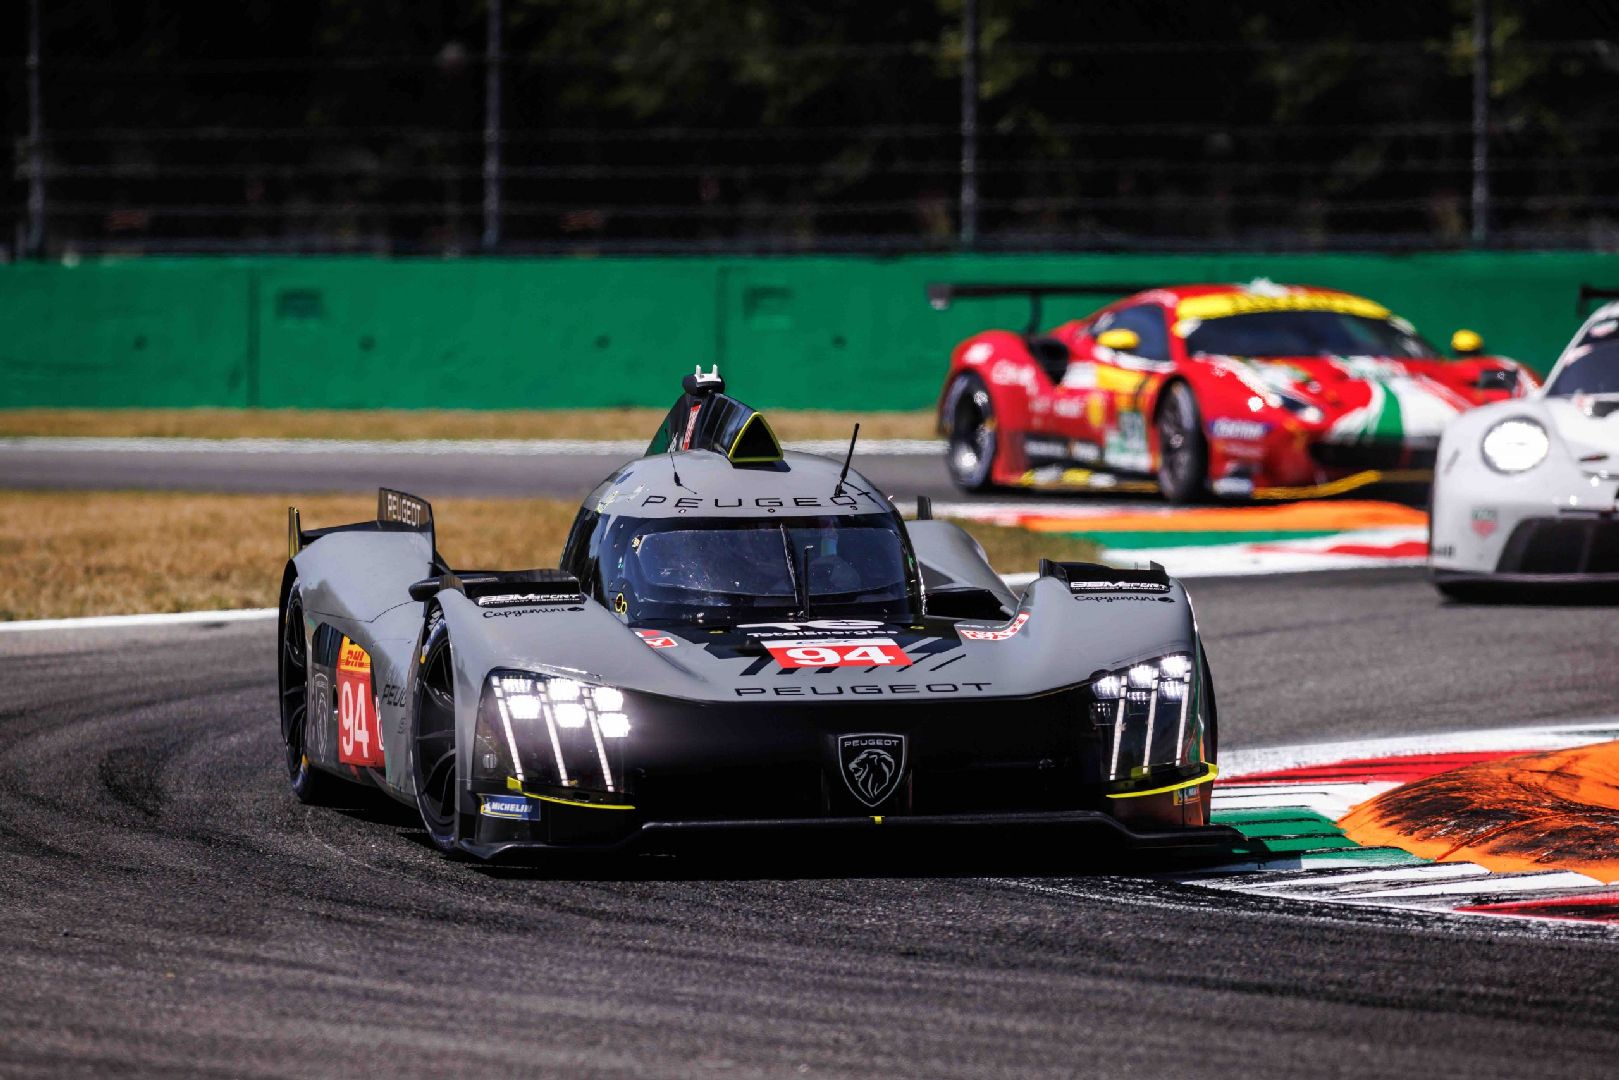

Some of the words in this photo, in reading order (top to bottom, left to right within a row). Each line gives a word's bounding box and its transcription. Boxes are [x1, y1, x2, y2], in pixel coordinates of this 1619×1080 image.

[641, 491, 874, 508] PEUGEOT
[387, 493, 421, 528] PEUGEOT
[483, 607, 565, 618] Capgemini
[746, 630, 898, 638] TotalEnergies
[345, 650, 365, 668] DHL
[785, 646, 896, 665] 94
[733, 682, 993, 697] PEUGEOT
[342, 681, 370, 758] 94
[843, 738, 900, 748] PEUGEOT
[491, 801, 533, 813] MICHELIN
